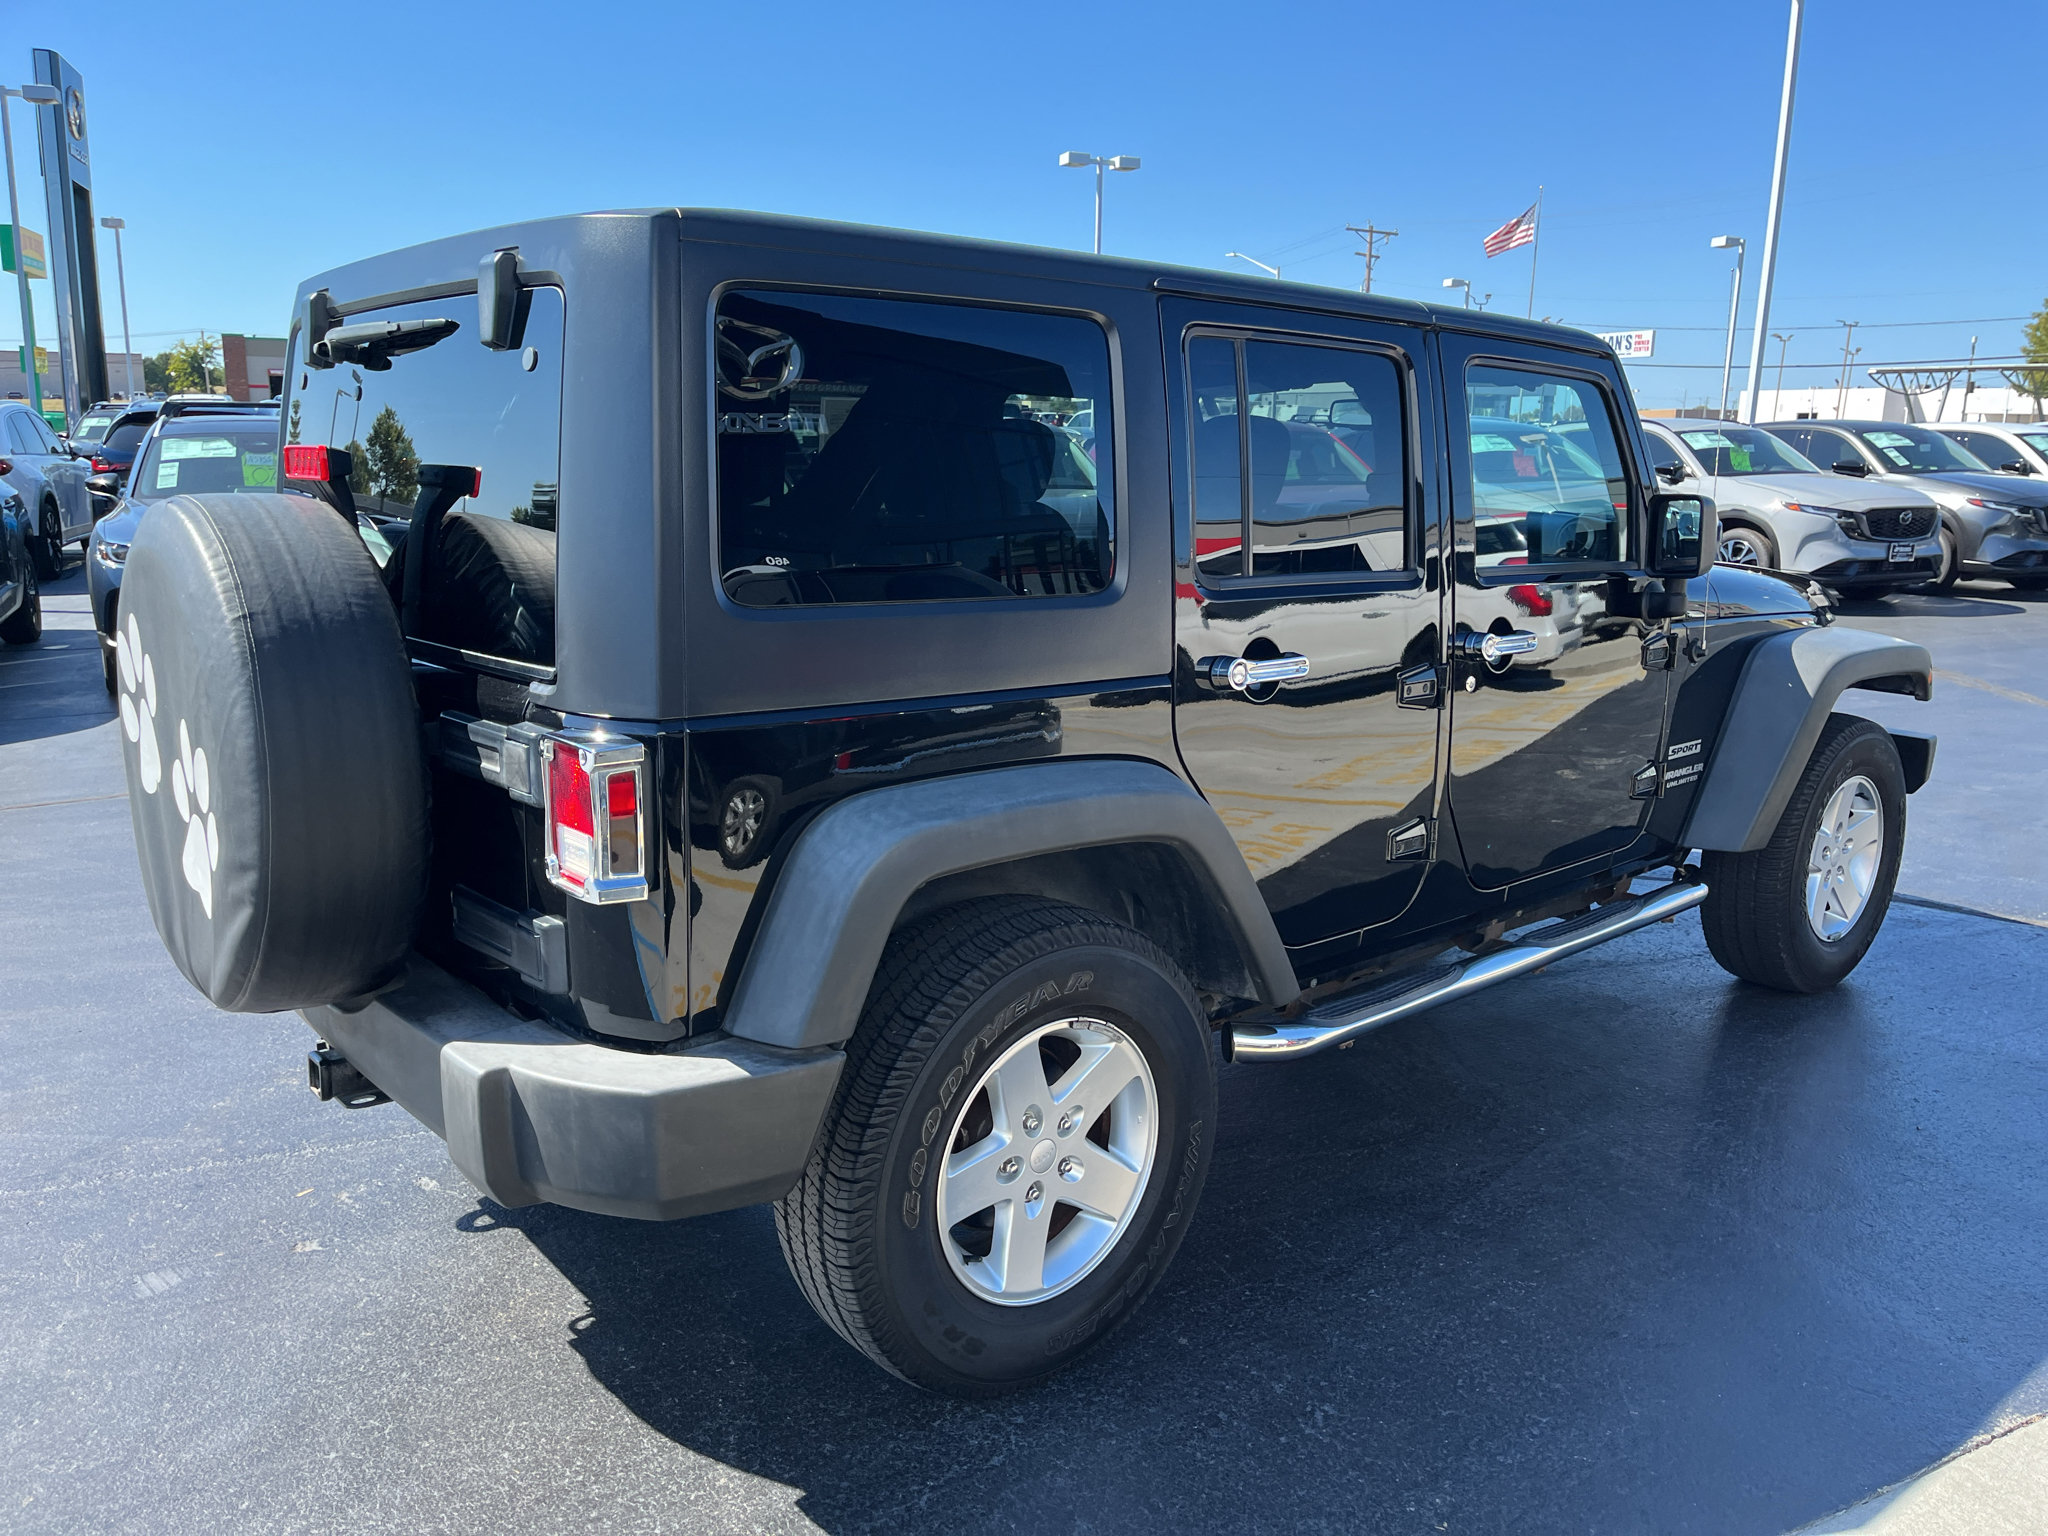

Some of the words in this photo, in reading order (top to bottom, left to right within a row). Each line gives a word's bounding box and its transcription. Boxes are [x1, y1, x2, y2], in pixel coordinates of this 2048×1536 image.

[1668, 742, 1701, 757] SPORT
[1666, 775, 1698, 789] UNLIMITED
[903, 970, 1095, 1229] GOODYEAR
